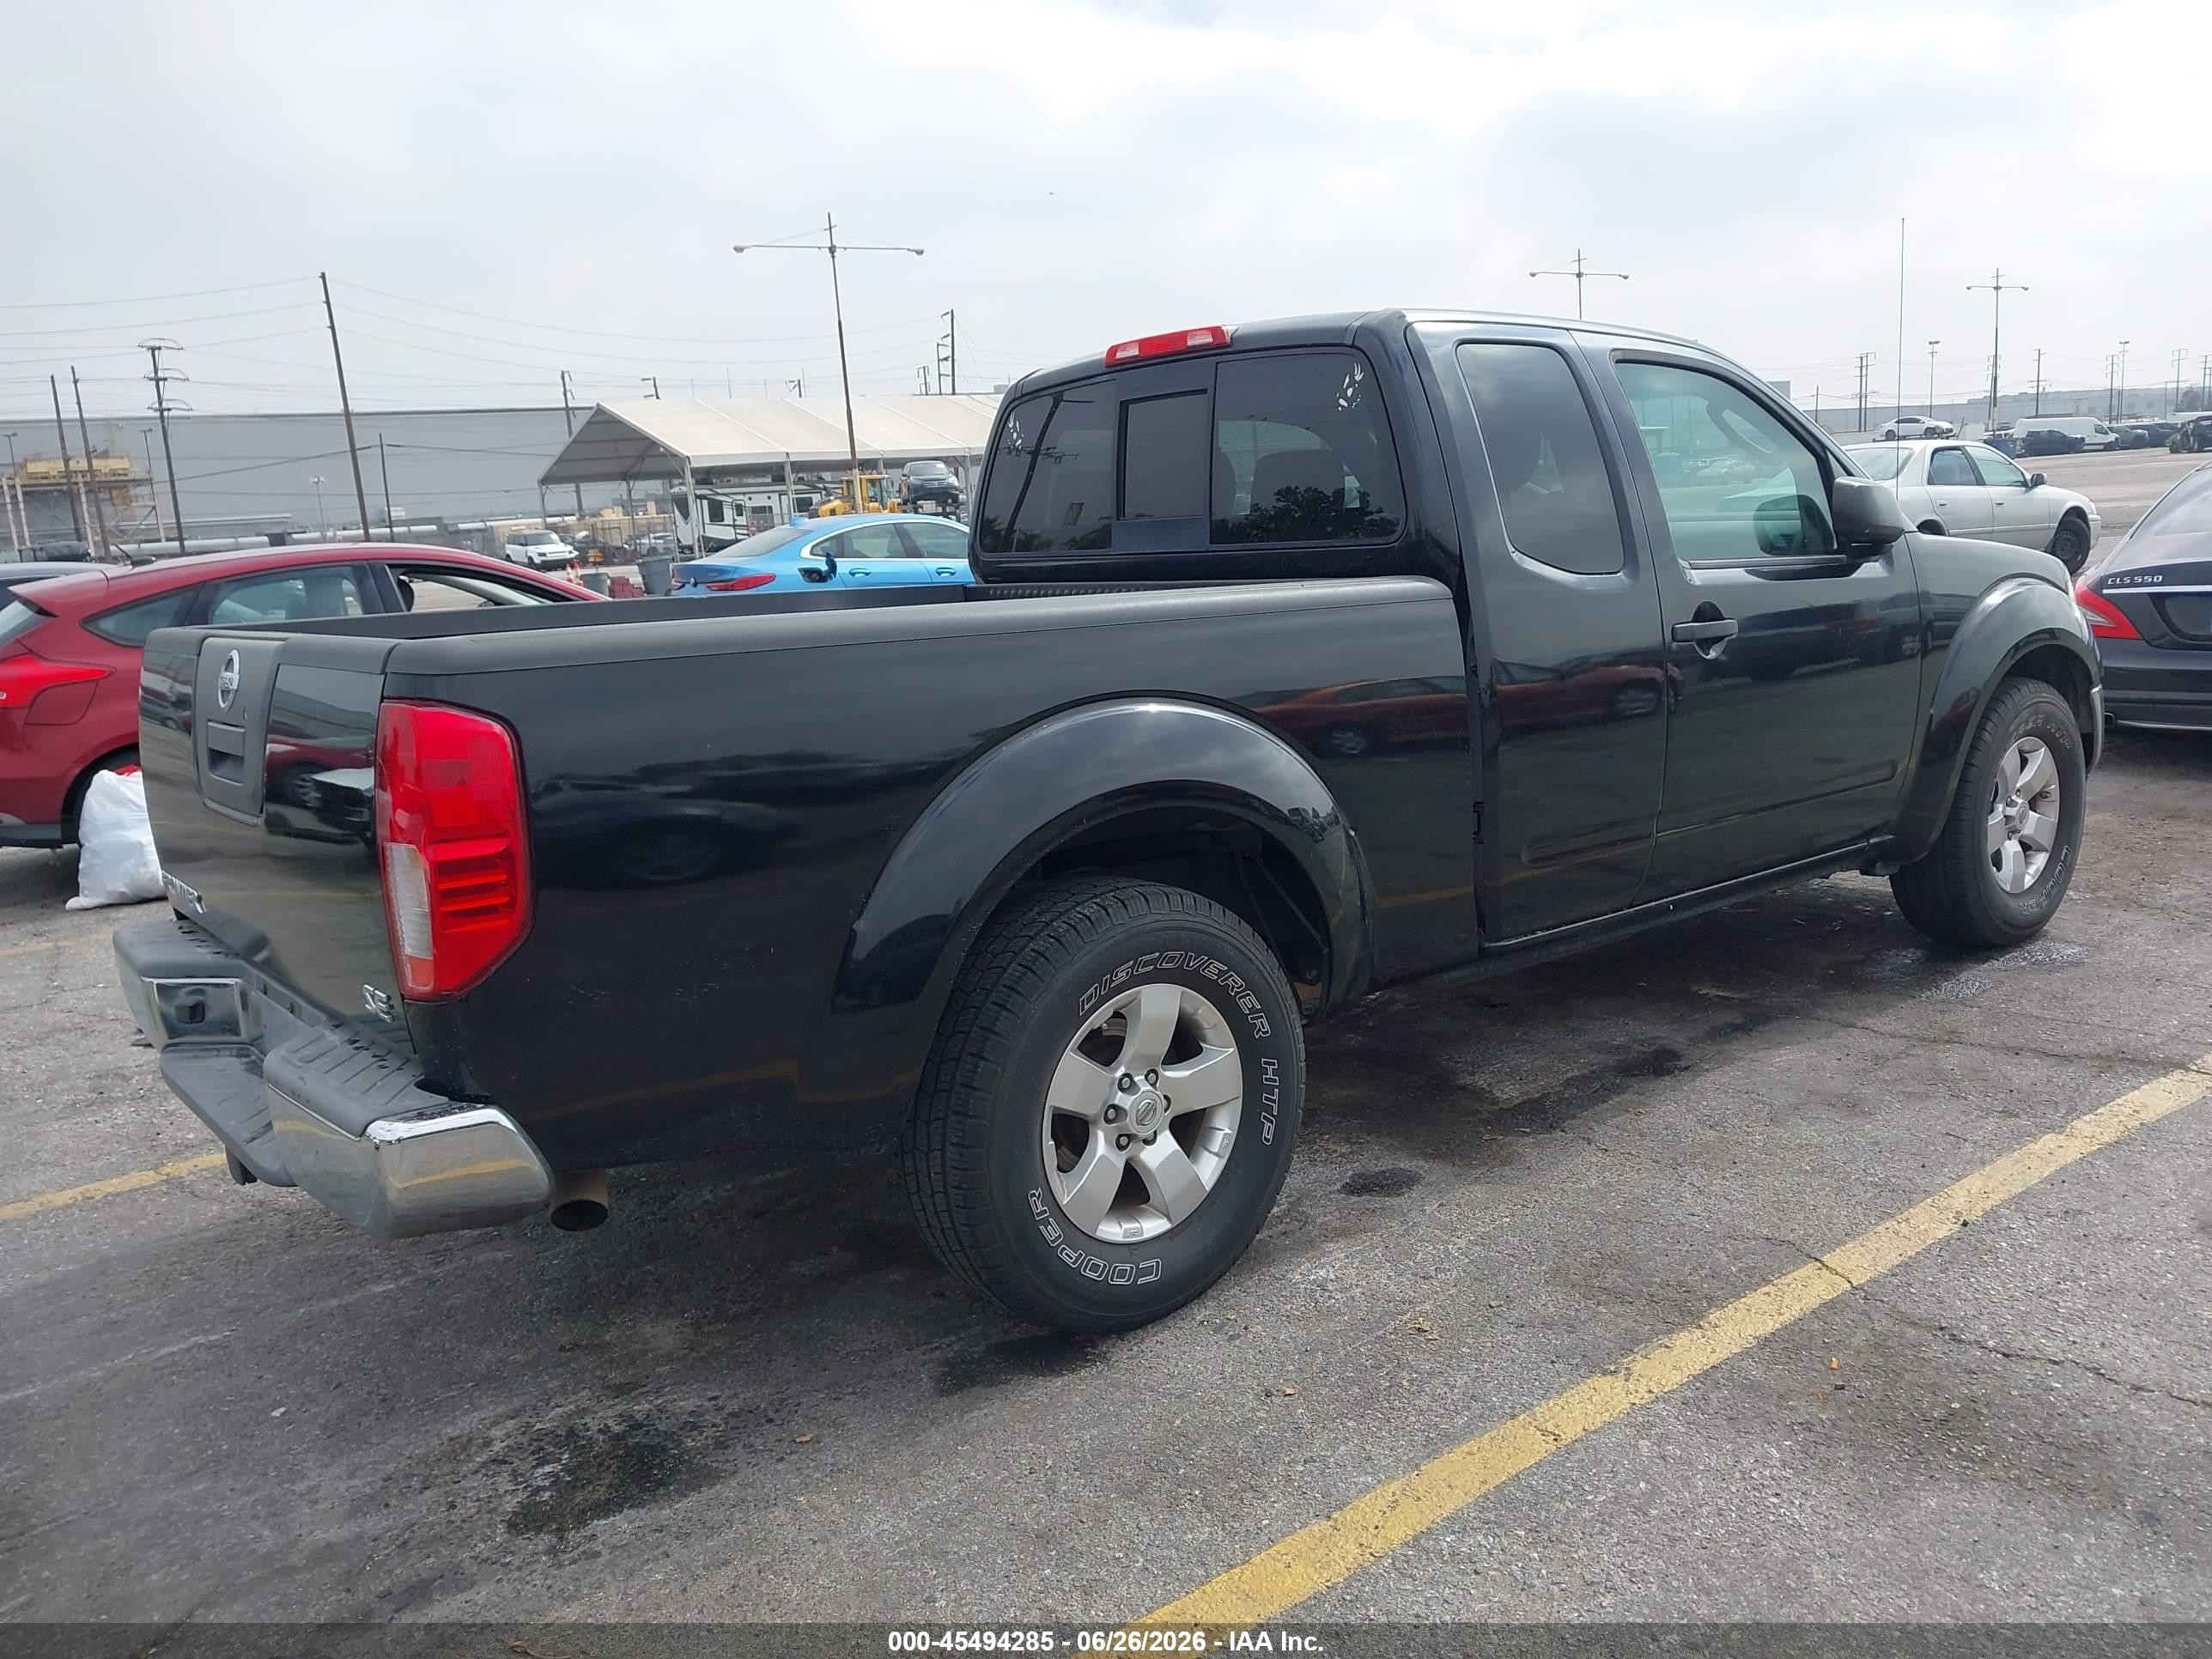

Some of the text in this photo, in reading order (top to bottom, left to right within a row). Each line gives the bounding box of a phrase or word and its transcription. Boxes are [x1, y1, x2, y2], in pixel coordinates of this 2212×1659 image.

[2107, 574, 2163, 585] CLS 550
[363, 984, 392, 1023] SE
[1079, 951, 1279, 1146] DISCOVERER HTP
[1028, 1187, 1163, 1285] COOPER
